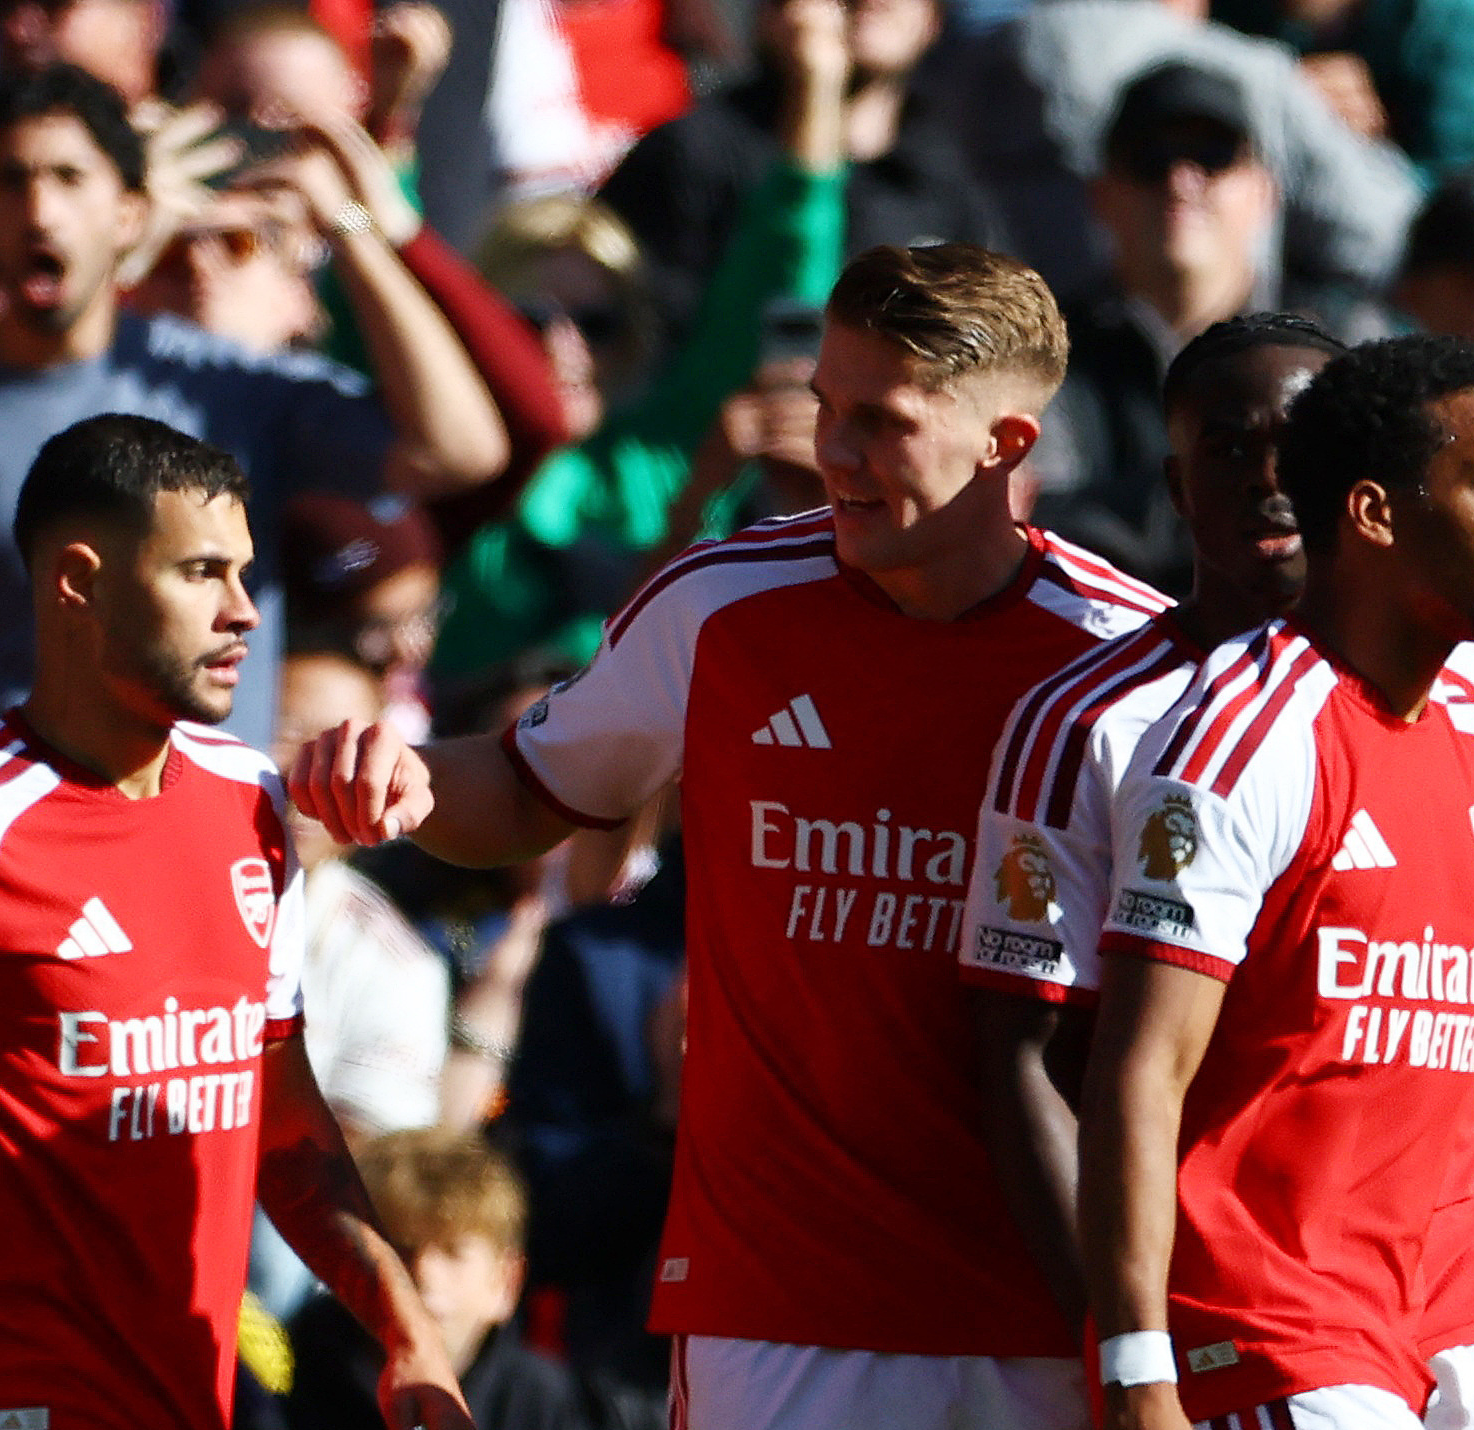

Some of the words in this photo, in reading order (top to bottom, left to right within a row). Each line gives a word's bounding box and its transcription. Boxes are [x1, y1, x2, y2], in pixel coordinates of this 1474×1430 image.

[750, 800, 967, 886] Emira
[786, 885, 858, 943] FLY
[867, 892, 965, 953] BETT
[59, 996, 265, 1077] Emirate
[1342, 1005, 1411, 1064] FLY
[109, 1083, 160, 1141] FLY
